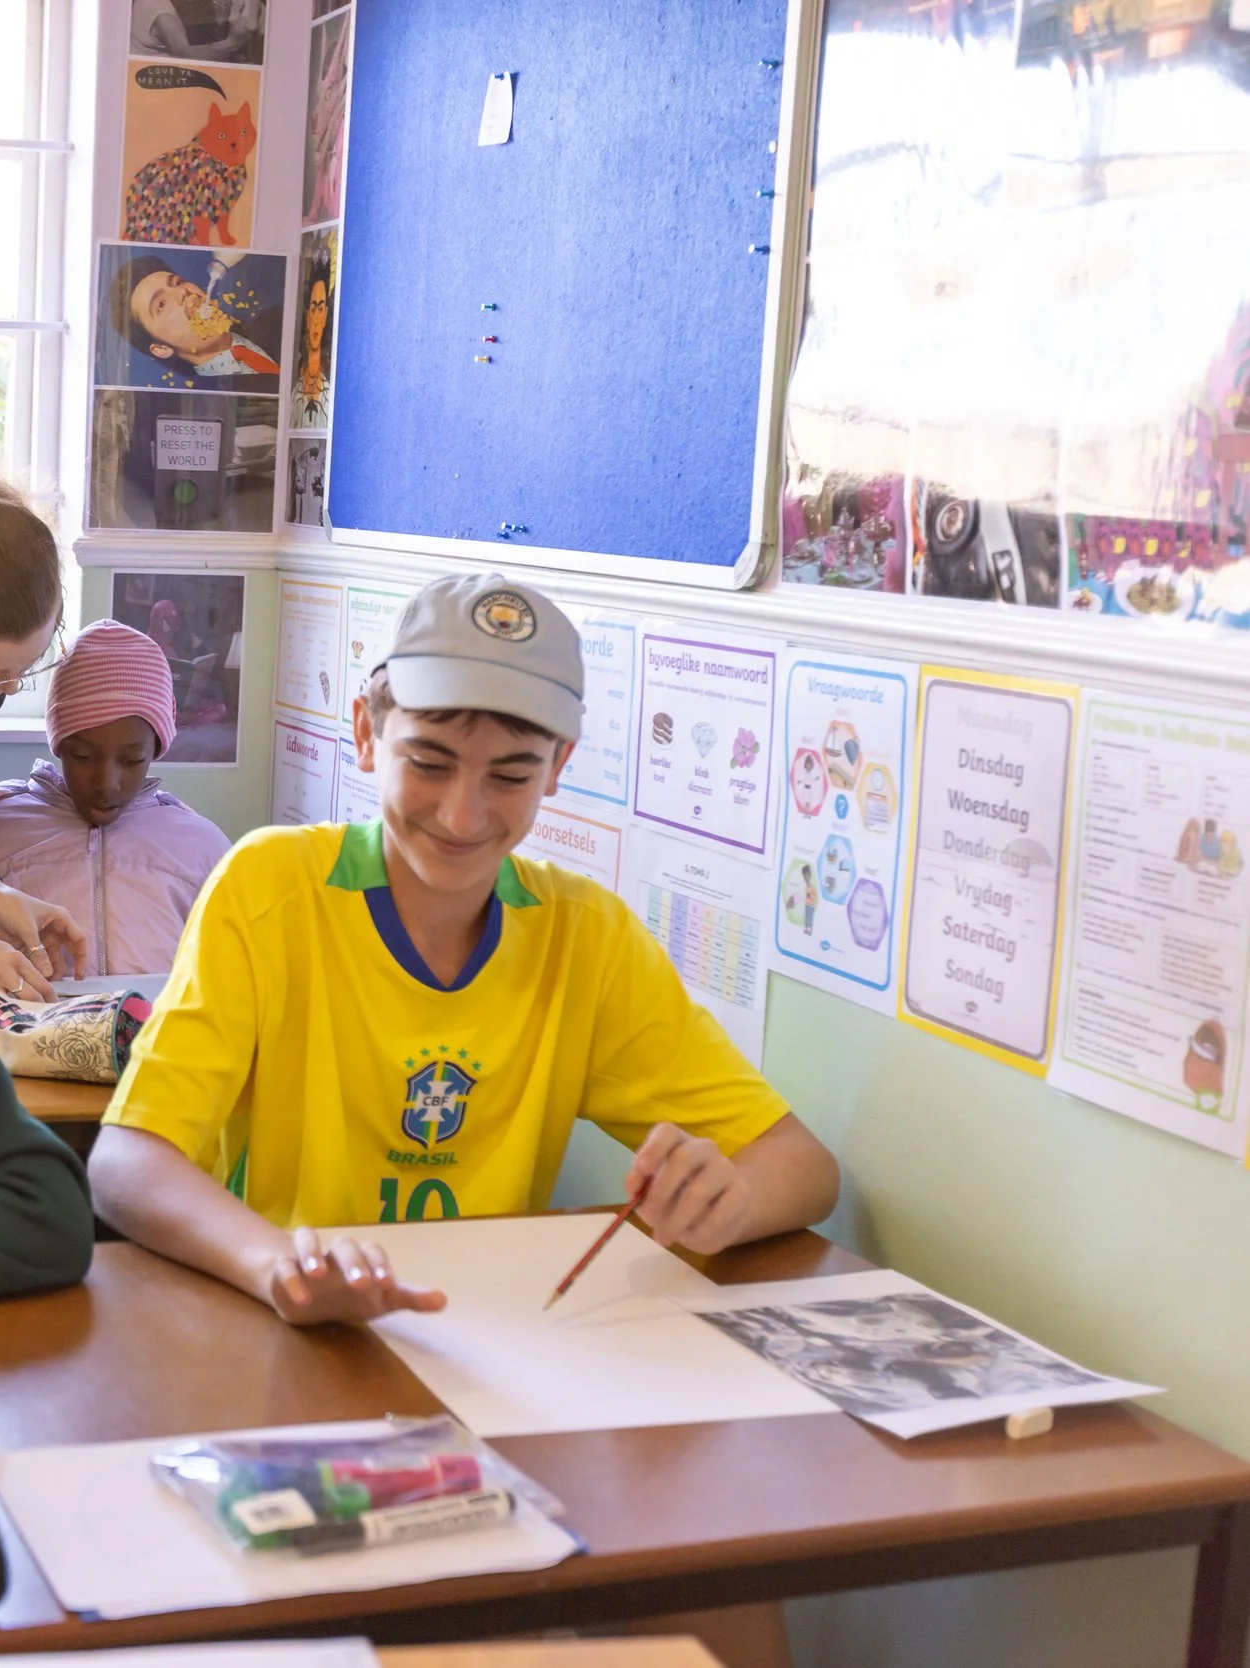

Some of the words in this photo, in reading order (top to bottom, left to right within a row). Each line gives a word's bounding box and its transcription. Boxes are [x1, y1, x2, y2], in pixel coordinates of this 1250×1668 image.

[137, 77, 172, 85] MEAN
[148, 67, 174, 76] LOVE
[161, 440, 191, 450] RESET
[194, 441, 215, 451] THE
[164, 425, 196, 435] PRESS
[199, 426, 212, 436] TO
[168, 455, 207, 466] WORLD
[649, 647, 701, 675] byvoeglike
[704, 662, 769, 685] naamwoord
[807, 676, 885, 704] Vraagwoorde
[956, 706, 1034, 745] Maandag
[286, 734, 319, 762] lidwoorde
[958, 747, 1024, 788] Dinsdag
[947, 788, 1030, 834] Woensdag
[534, 822, 597, 855] oorsetsels
[943, 829, 1031, 879] Donderdag
[954, 874, 1013, 917] Vrydag
[943, 915, 1016, 963] Saterdag
[944, 958, 1005, 1004] Sondag
[422, 1095, 450, 1107] CBF
[386, 1149, 459, 1167] BRASIL
